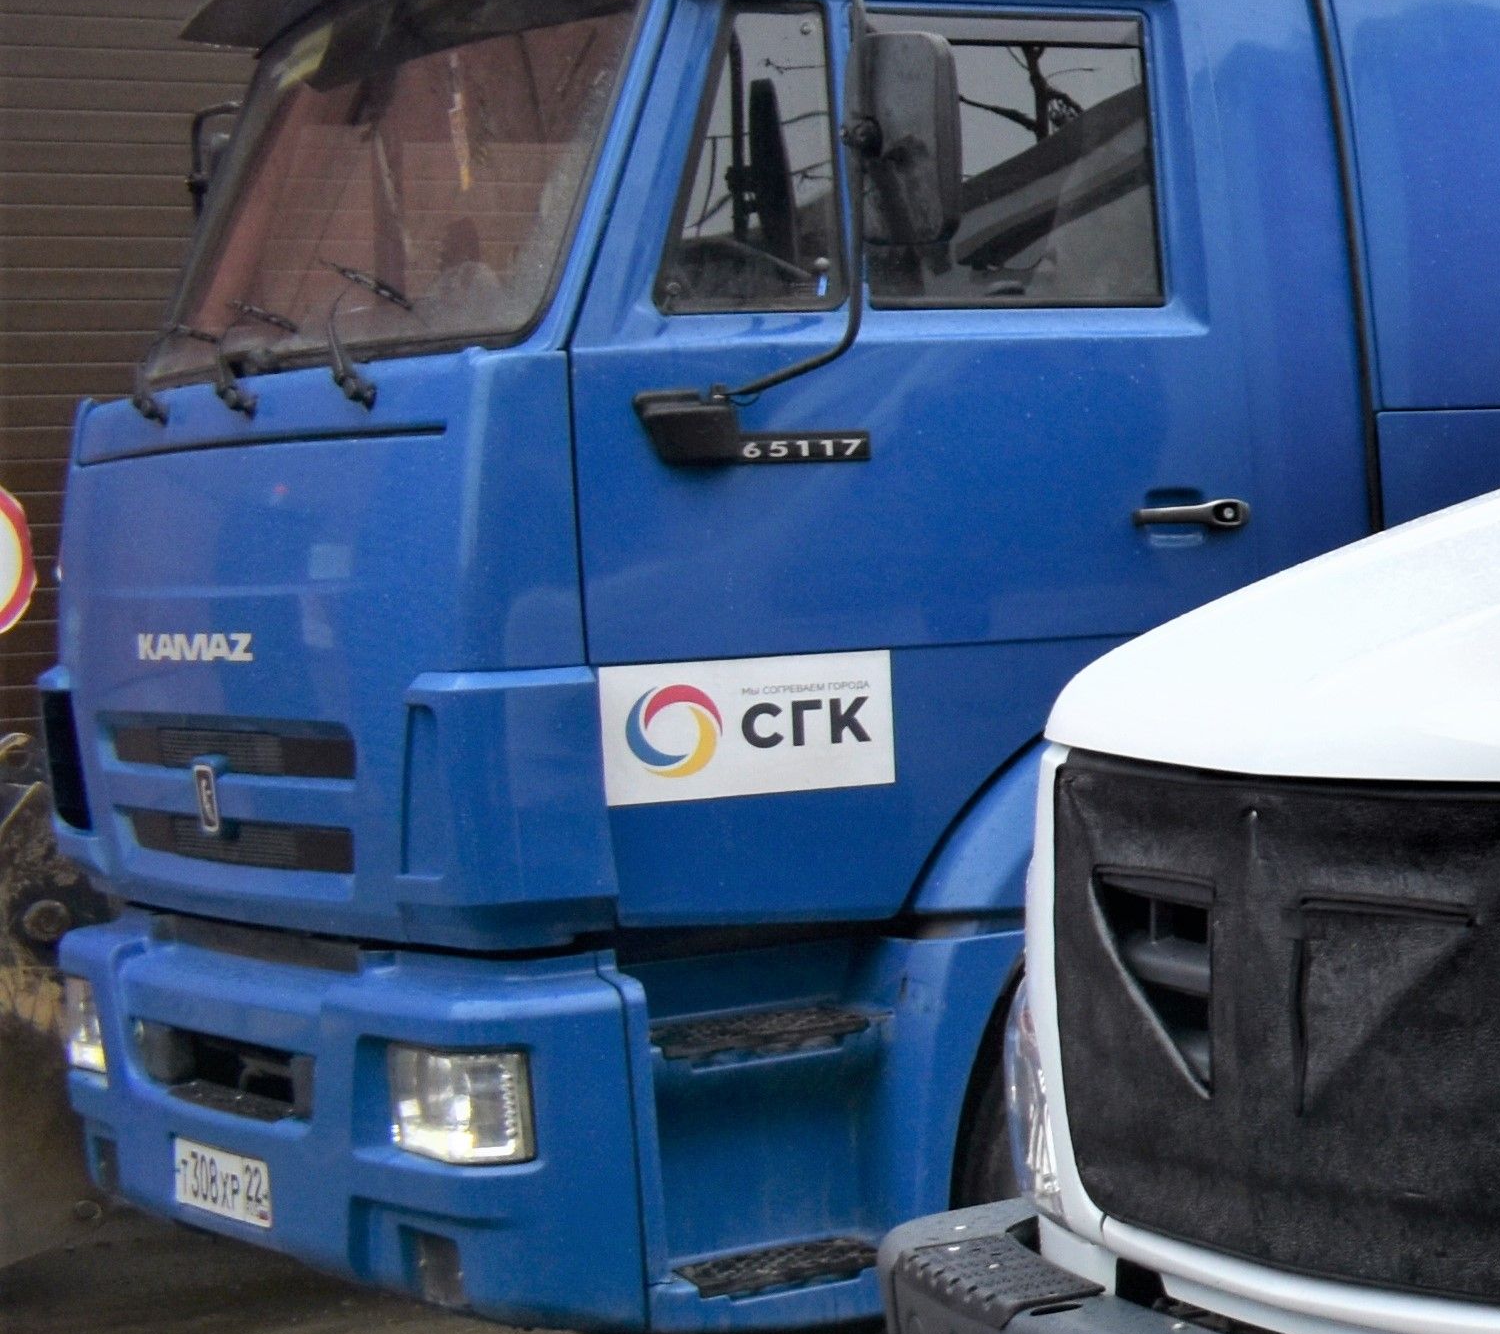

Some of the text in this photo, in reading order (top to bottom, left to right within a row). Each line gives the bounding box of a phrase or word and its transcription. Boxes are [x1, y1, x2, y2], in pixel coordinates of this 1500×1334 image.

[742, 438, 863, 458] 65117
[137, 633, 253, 661] KAMAZ
[762, 682, 826, 695] СОГРЕВАЕМ
[828, 679, 870, 691] ГОРОДА
[741, 695, 872, 749] СГК
